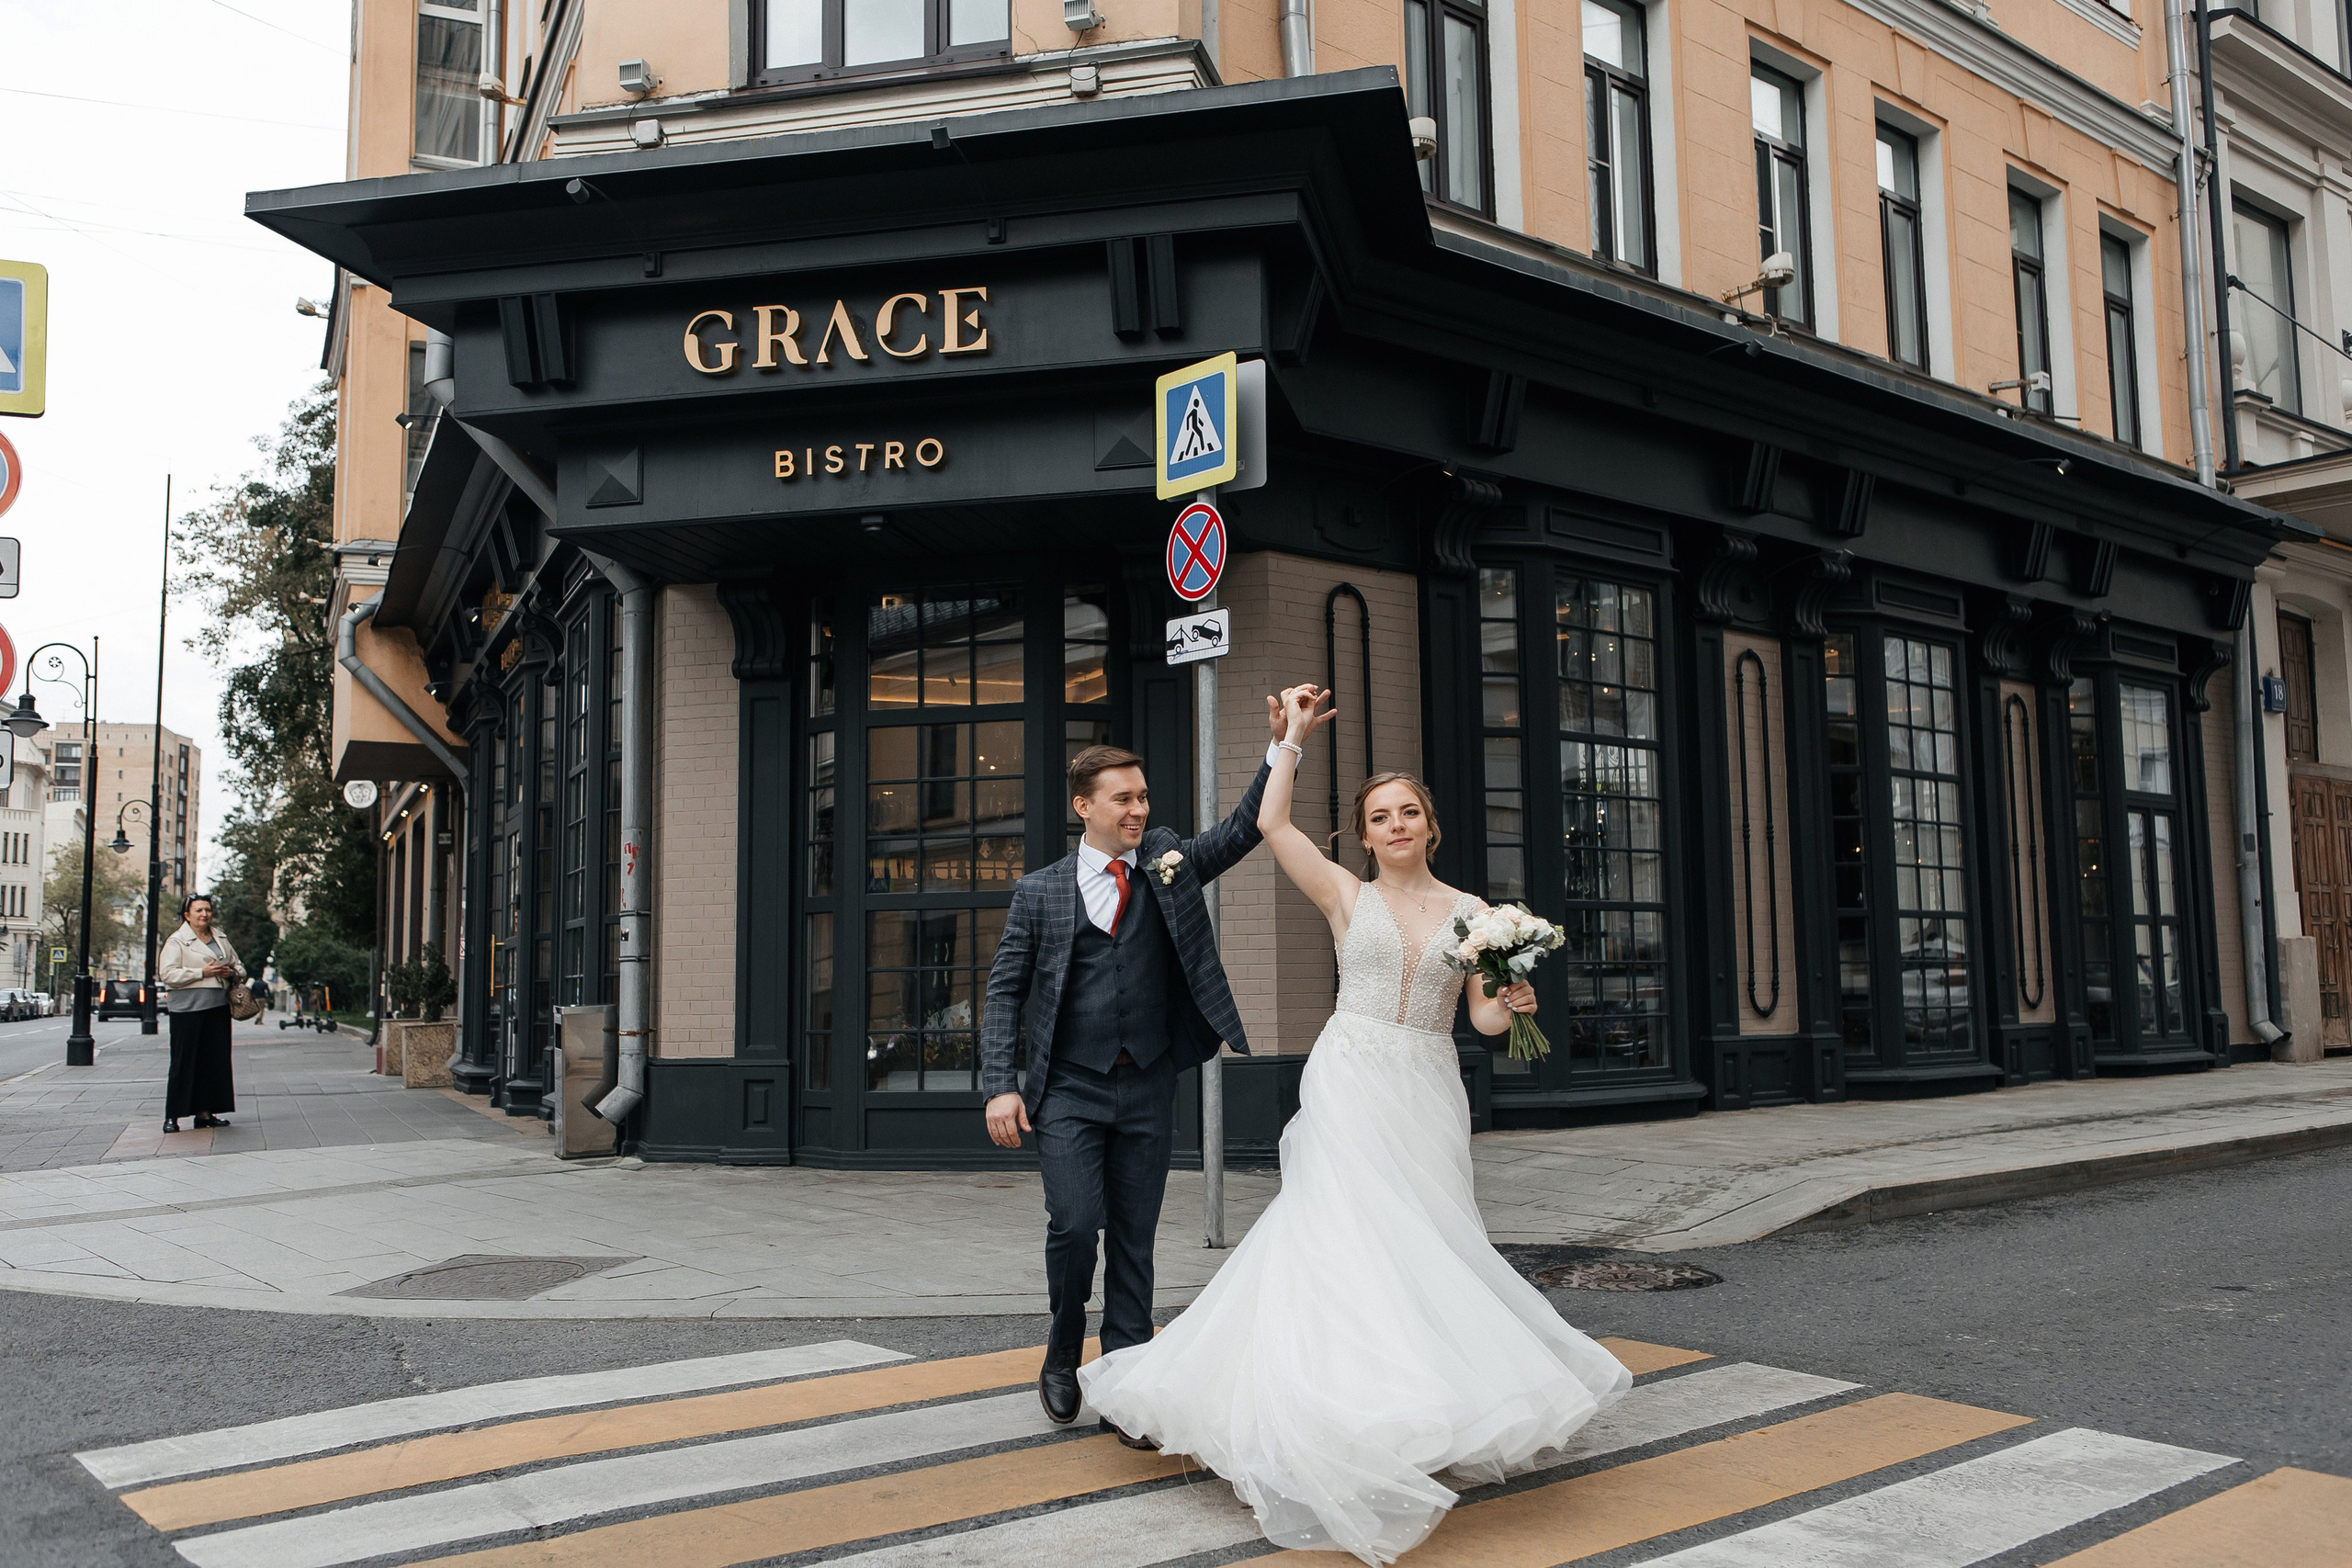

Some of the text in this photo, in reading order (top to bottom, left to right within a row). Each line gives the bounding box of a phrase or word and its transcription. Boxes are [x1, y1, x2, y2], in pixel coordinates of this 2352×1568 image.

[684, 287, 988, 373] GRACE
[775, 437, 944, 479] BISTRO
[2274, 684, 2284, 701] 18
